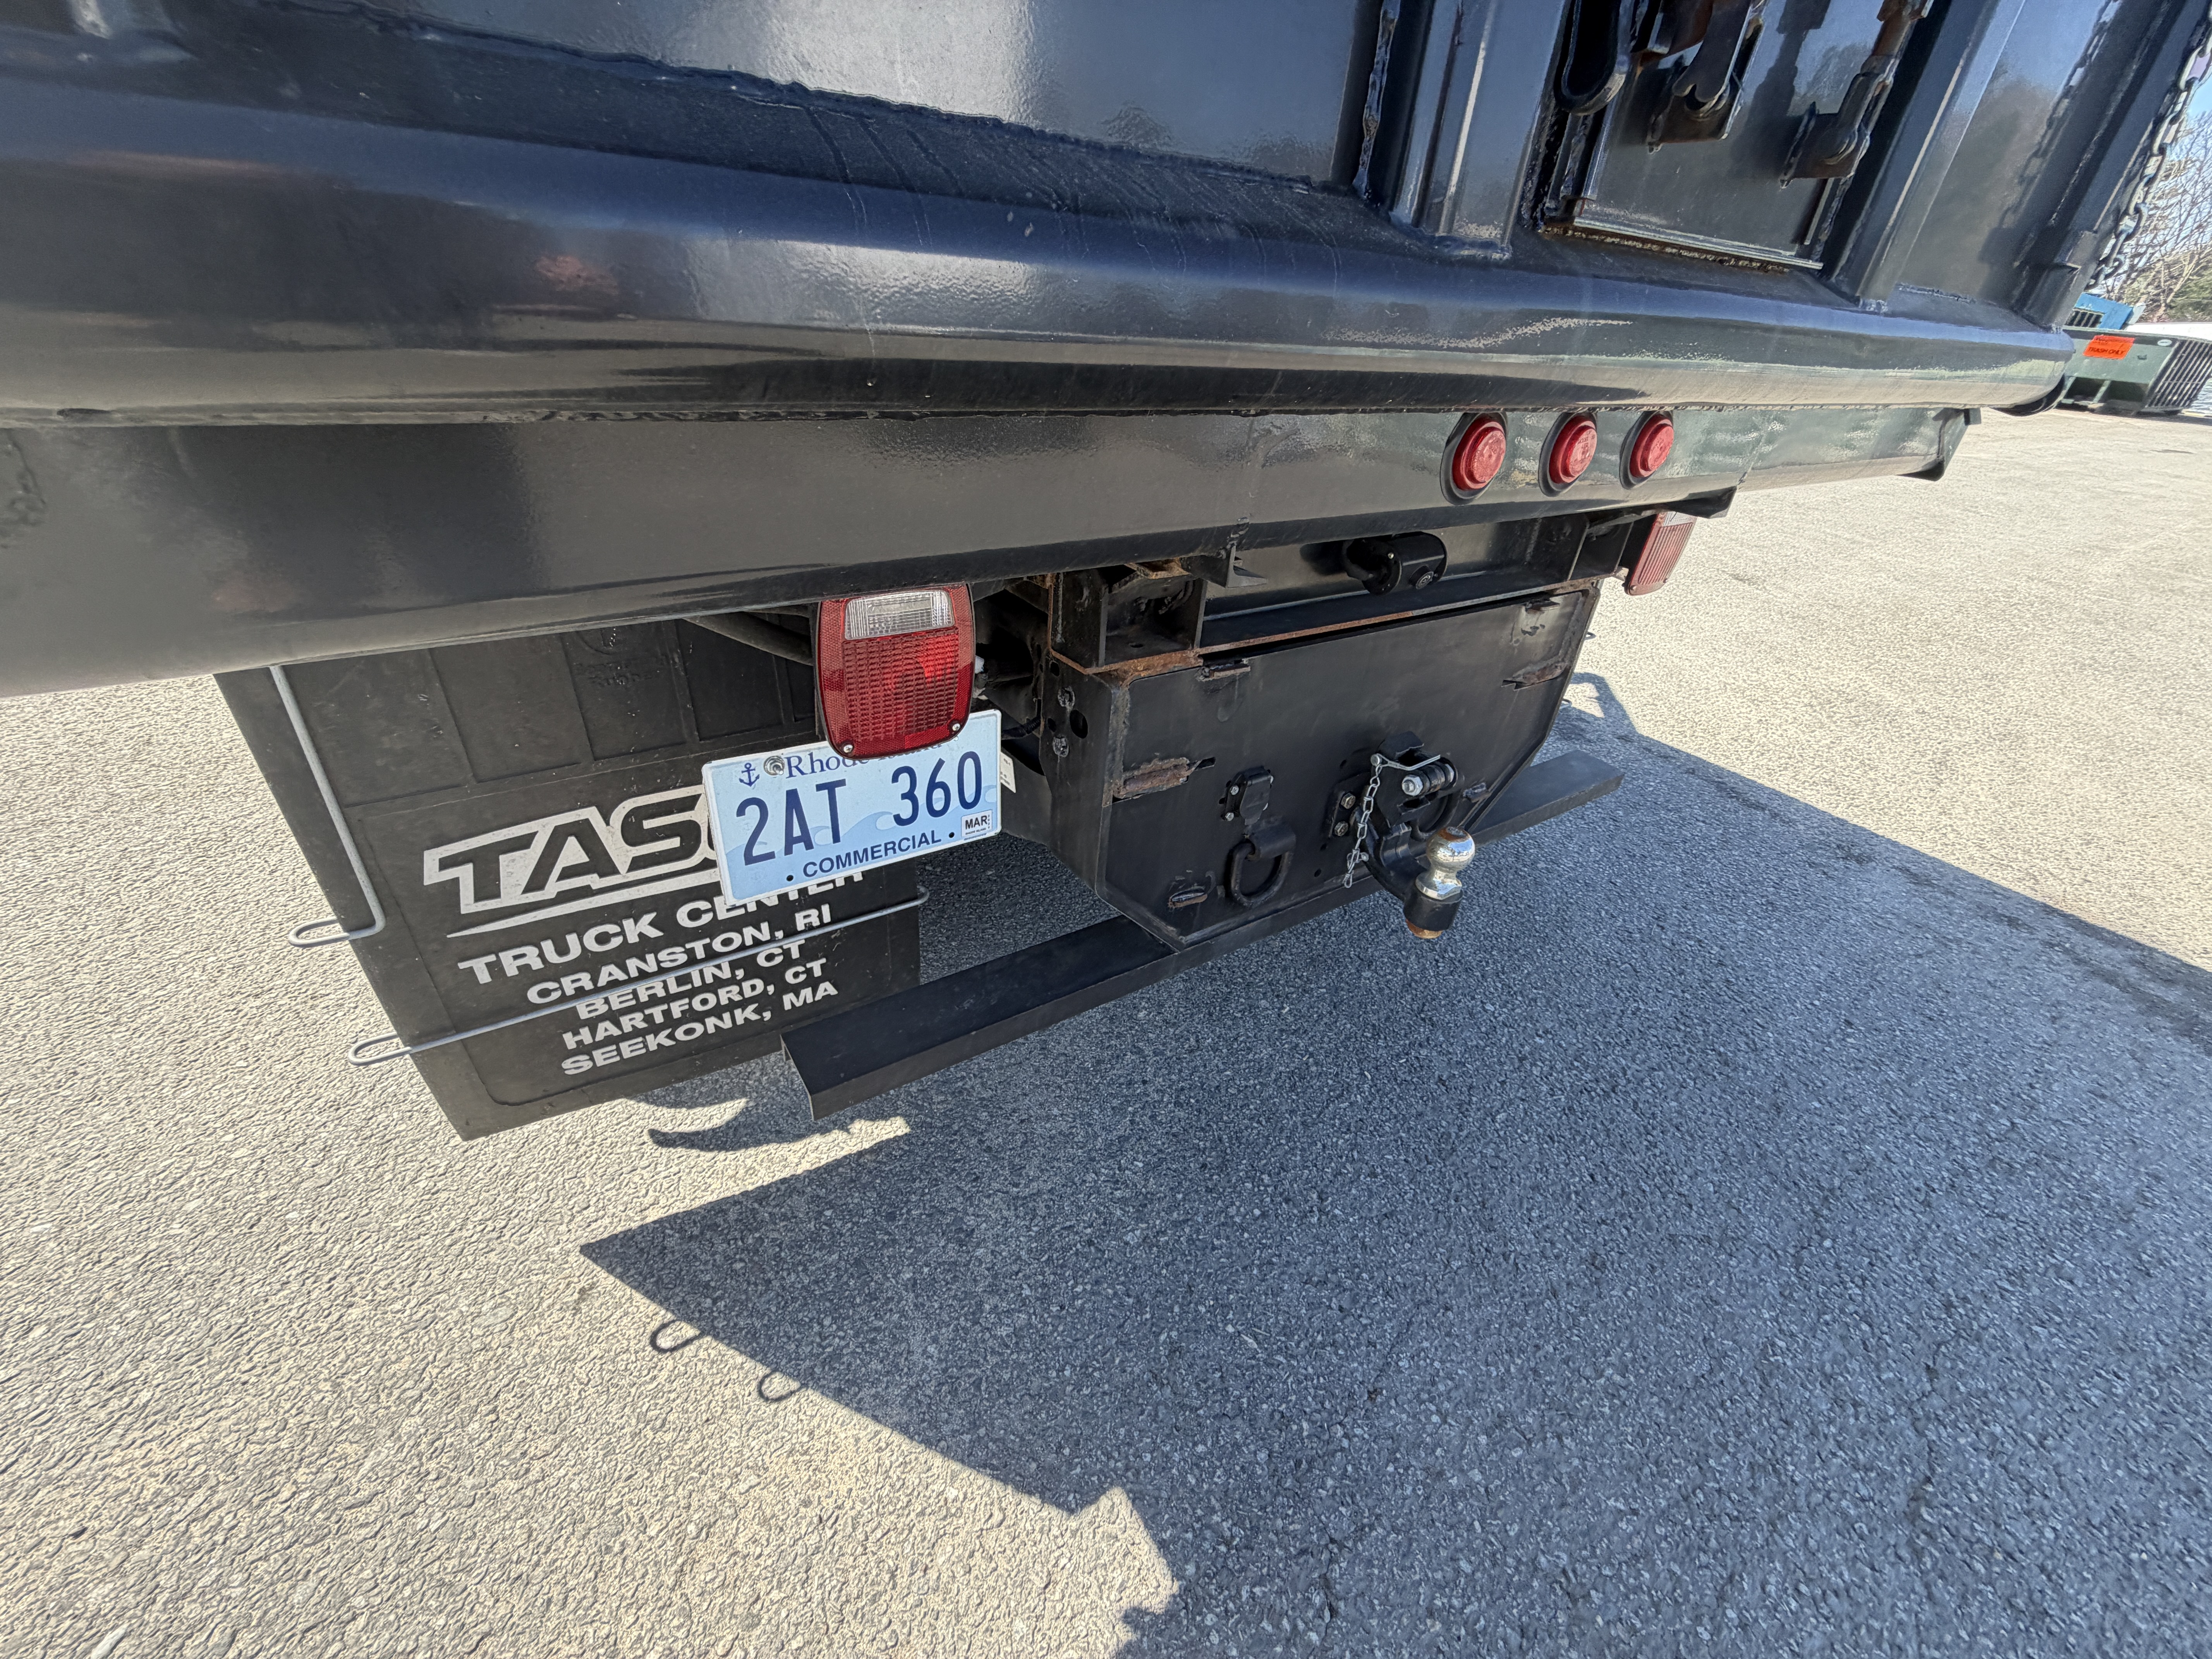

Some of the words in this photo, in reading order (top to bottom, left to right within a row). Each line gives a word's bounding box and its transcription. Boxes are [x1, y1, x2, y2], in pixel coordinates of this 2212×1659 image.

[736, 778, 847, 866] 2AT
[891, 751, 982, 826] 360
[783, 751, 869, 779] Rho
[423, 784, 717, 914] TAS
[803, 830, 942, 878] COMMERCIAL
[965, 815, 988, 830] MAR
[457, 911, 664, 984] TRUCK
[527, 921, 784, 1004] CRANSTON,
[795, 903, 831, 931] RI
[576, 961, 744, 1020] BERLIN,
[756, 939, 805, 967] CT
[561, 1003, 772, 1075] SEEKONK,
[782, 981, 838, 1010] MA
[562, 978, 775, 1050] HARTFORD,
[785, 957, 827, 984] CT
